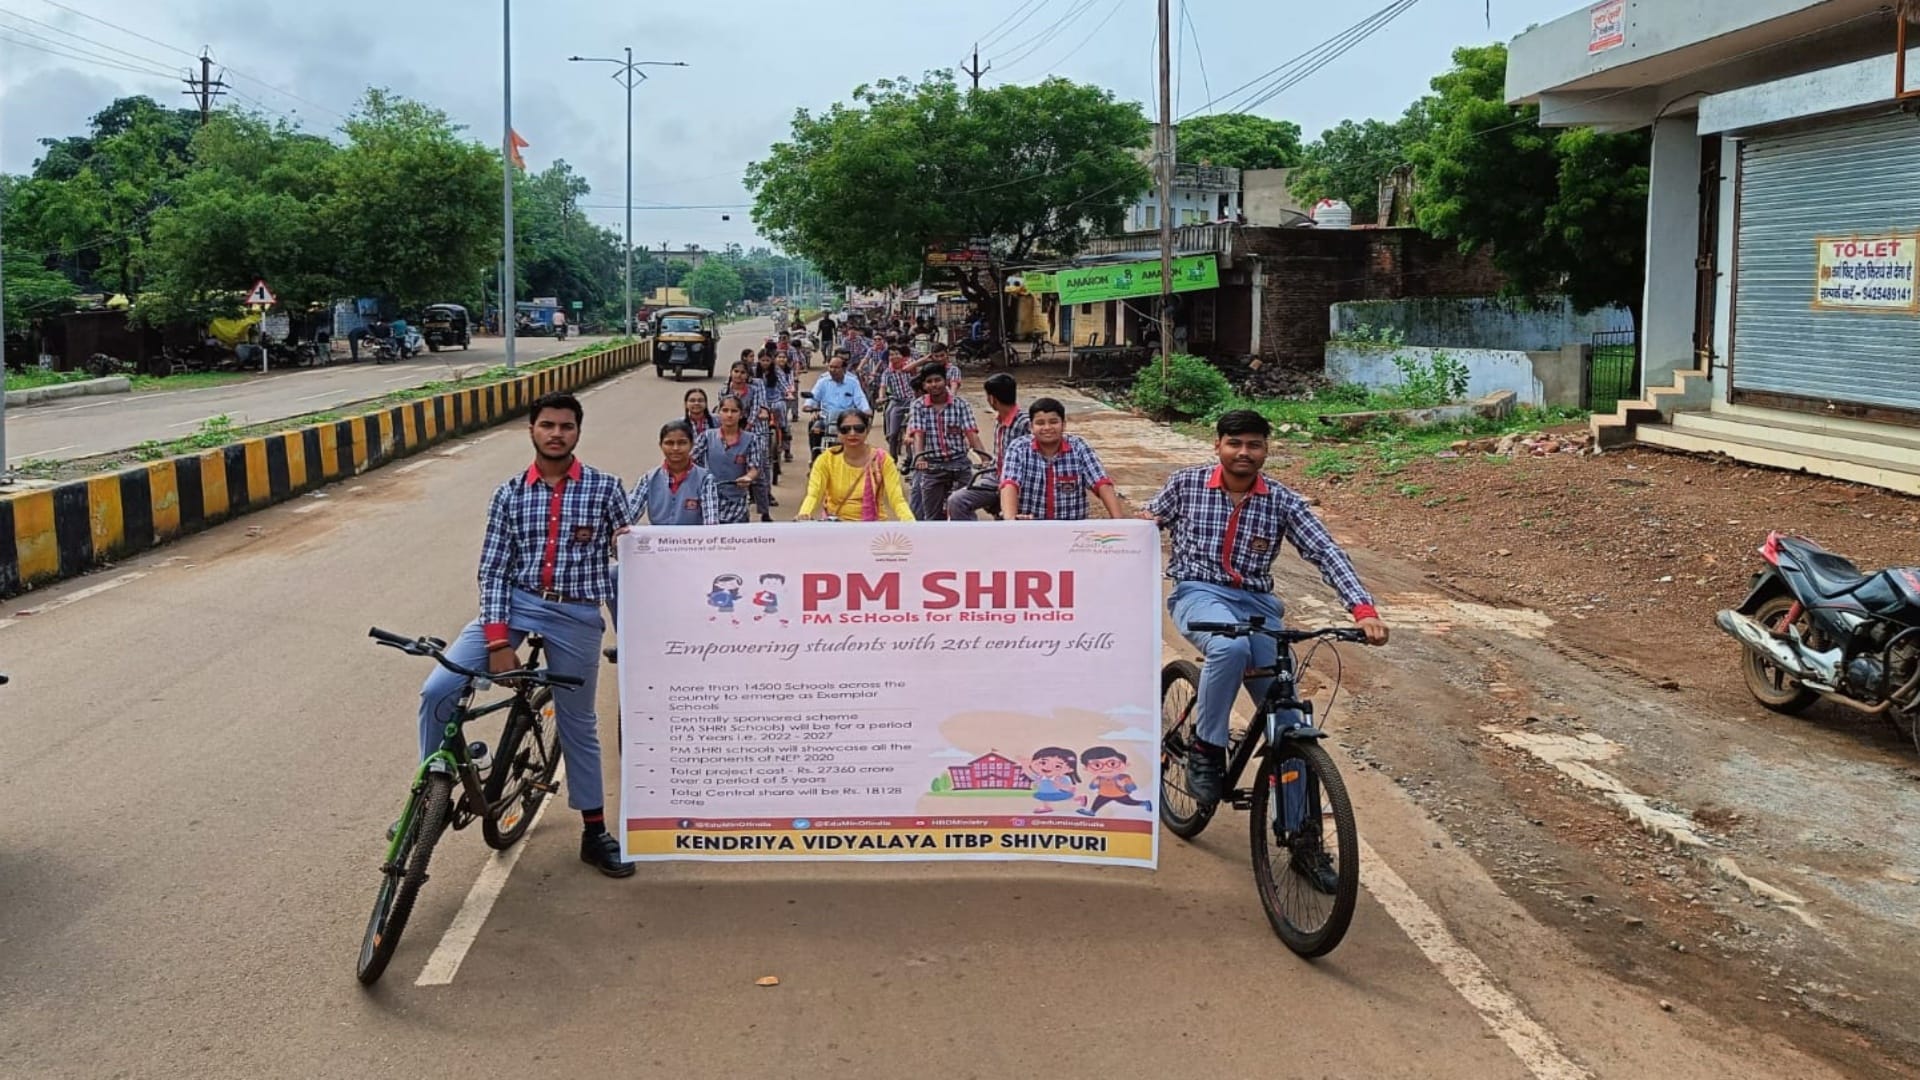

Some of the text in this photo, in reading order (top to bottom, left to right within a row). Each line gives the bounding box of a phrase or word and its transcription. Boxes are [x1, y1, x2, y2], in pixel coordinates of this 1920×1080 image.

[1833, 242, 1901, 257] TO-LET
[1142, 267, 1182, 280] AMAON
[1066, 276, 1109, 288] AMARON
[658, 535, 776, 546] Ministry of Education
[802, 570, 1075, 611] PM SHRI
[802, 614, 832, 625] PM
[926, 611, 952, 623] for
[960, 611, 1016, 624] Rising
[1023, 610, 1074, 622] India
[664, 632, 1115, 662] Empowering students with 21st century skills
[708, 684, 739, 692] than
[745, 683, 782, 691] 14500
[785, 682, 835, 691] Schools
[668, 694, 720, 702] country
[817, 691, 878, 700] Exemplar
[669, 703, 720, 711] Schools
[669, 713, 859, 723] Centrally sponsored scheme
[670, 725, 695, 733] (PM
[699, 724, 727, 732] SHRI
[730, 724, 785, 732] Schools)
[812, 723, 831, 731] be
[835, 722, 852, 730] for
[869, 721, 912, 731] period
[669, 734, 682, 742] of
[686, 734, 694, 742] 5
[698, 733, 734, 742] Years
[760, 732, 792, 741] 2022
[803, 732, 833, 740] 2027
[670, 743, 912, 754] PM SHRI schools will showcase all the
[670, 755, 755, 764] components
[775, 754, 802, 762] NEP
[804, 753, 835, 761] 2020
[671, 767, 702, 776] Total
[706, 767, 753, 776] project
[756, 767, 785, 775] cost
[817, 766, 856, 774] 27360
[716, 776, 760, 786] period
[763, 776, 777, 784] of
[781, 776, 788, 784] 5
[791, 777, 827, 785] years
[671, 788, 702, 797] Total
[705, 788, 755, 797] Central
[866, 787, 902, 795] 18128
[669, 799, 705, 807] crore
[676, 834, 1107, 852] KENDRIYA VIDYALAYA ITBP SHIVPURI
